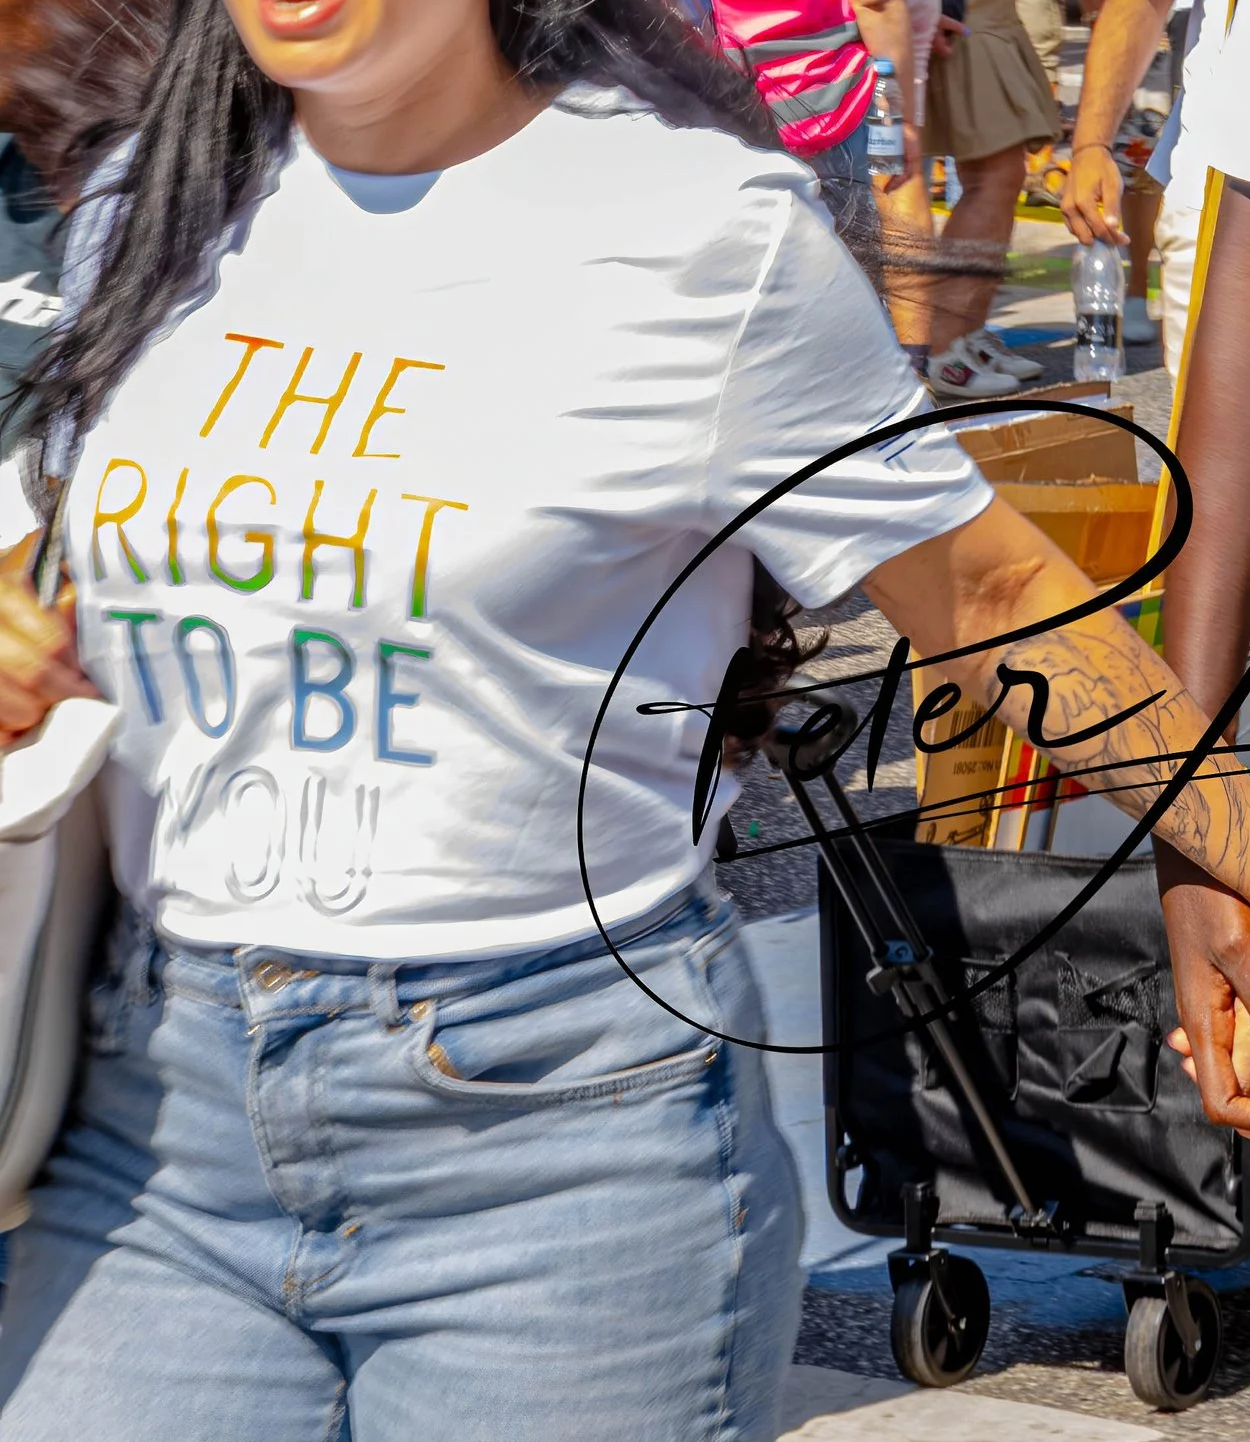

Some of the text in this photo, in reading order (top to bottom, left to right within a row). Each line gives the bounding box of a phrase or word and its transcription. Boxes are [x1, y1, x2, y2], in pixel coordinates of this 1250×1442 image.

[200, 333, 445, 458] THE
[93, 458, 470, 619] RIGHT
[109, 609, 437, 767] TO BE
[155, 764, 380, 916] YOU
